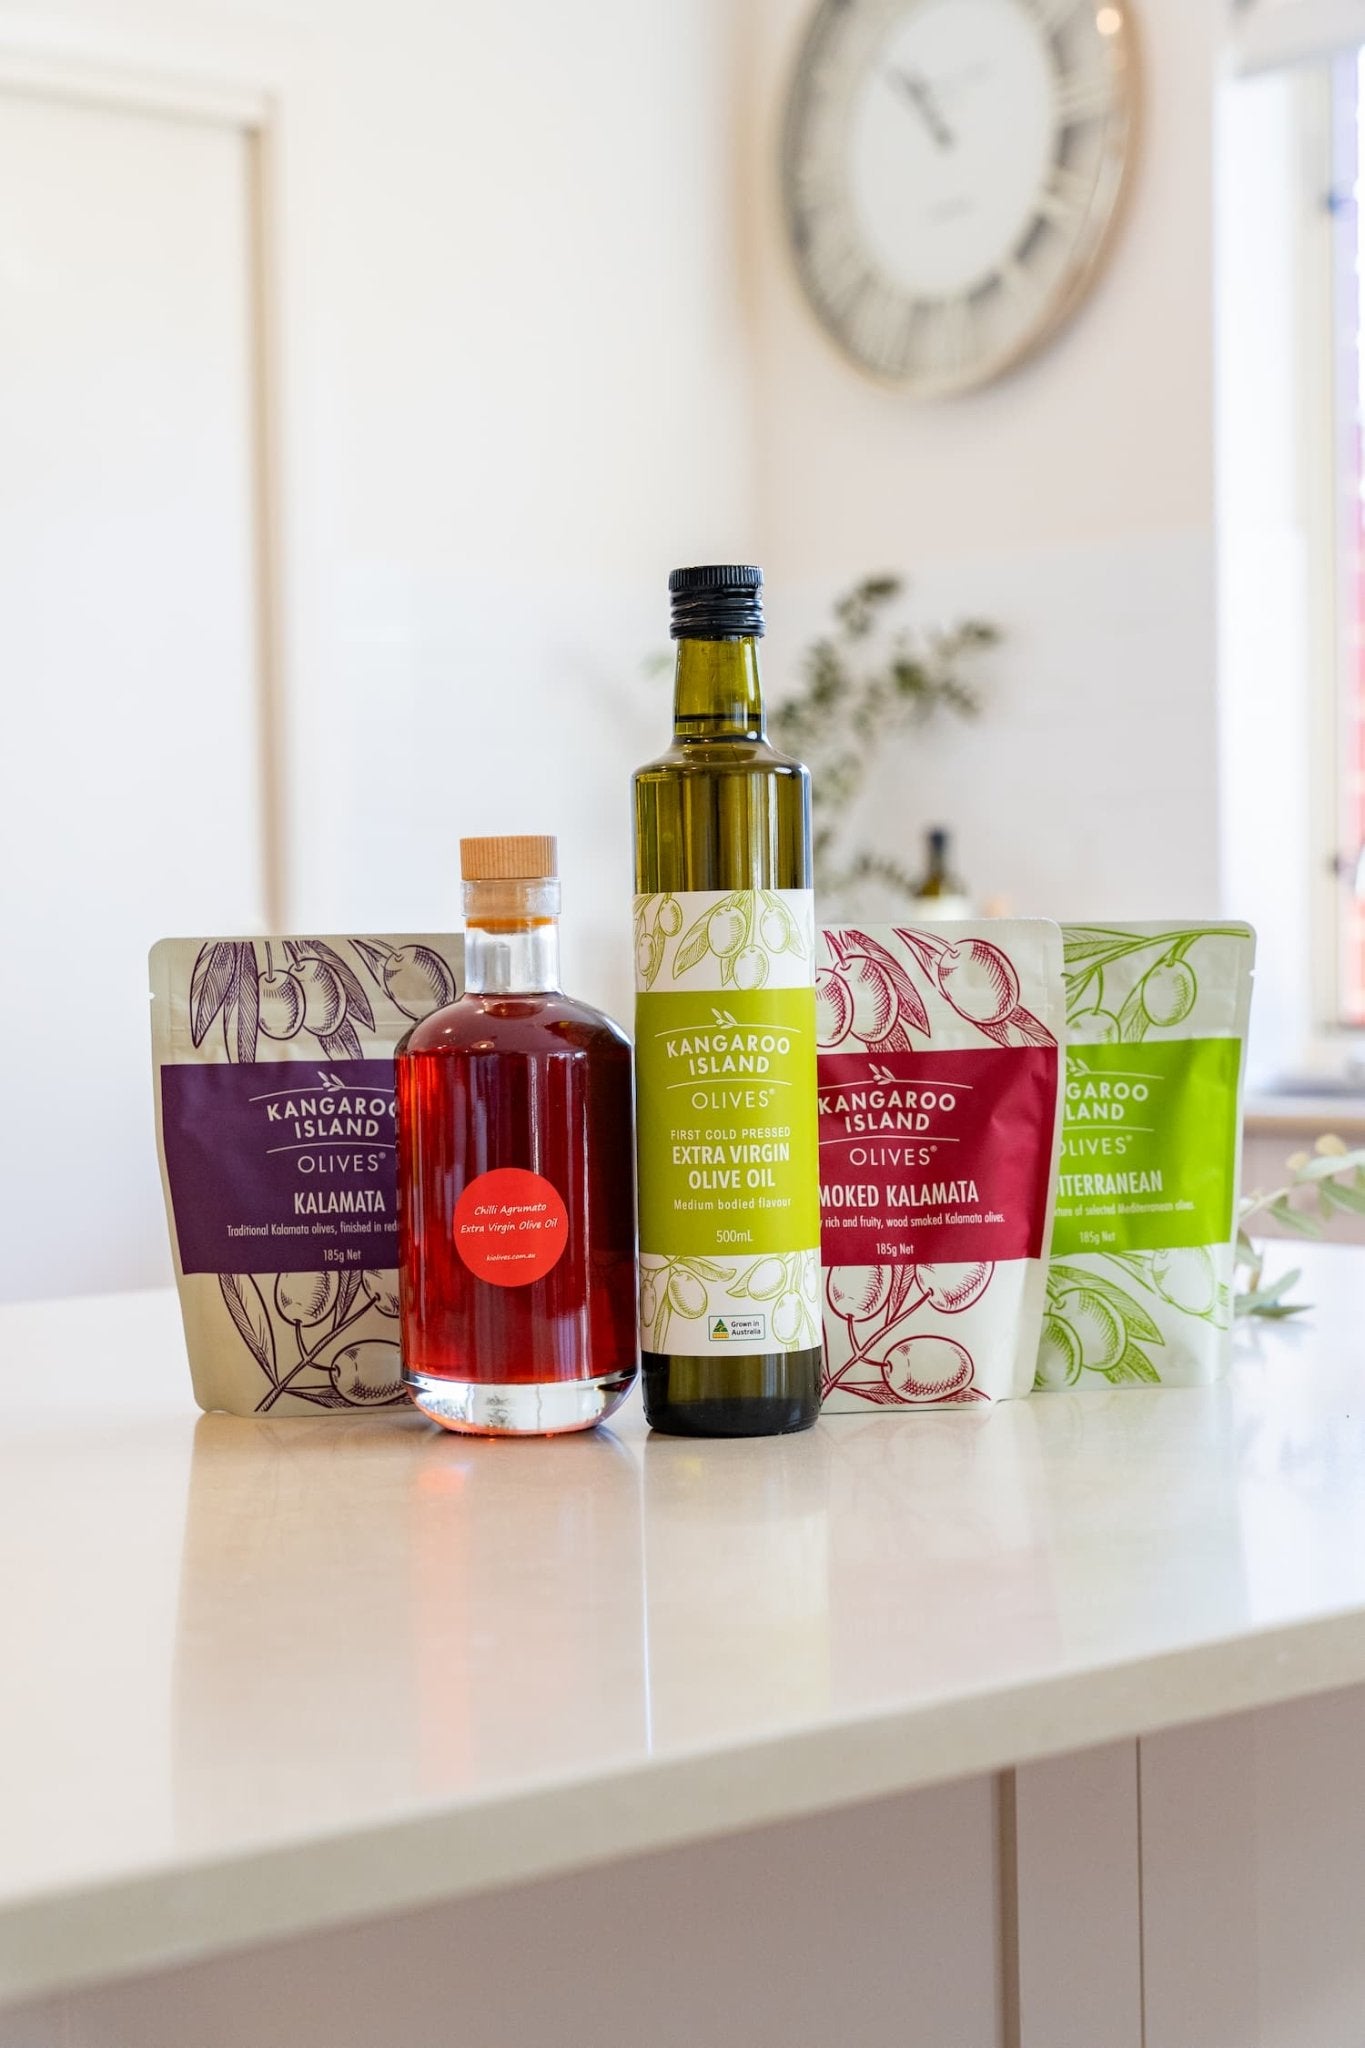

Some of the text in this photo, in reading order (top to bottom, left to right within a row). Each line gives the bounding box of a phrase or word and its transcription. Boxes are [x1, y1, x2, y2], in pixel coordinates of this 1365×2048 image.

[666, 1034, 790, 1058] KANGAROO
[689, 1055, 769, 1076] ISLAND
[1066, 1082, 1148, 1101] GAROO
[818, 1090, 956, 1115] KANGAROO
[1066, 1102, 1125, 1121] LAND
[294, 1118, 379, 1139] ISLAND
[845, 1111, 930, 1133] ISLAND
[670, 1126, 791, 1141] FIRST COLD PRESSED
[672, 1142, 790, 1165] EXTRA VIRGIN
[688, 1168, 776, 1189] OLIVE OIL
[1057, 1169, 1163, 1197] ITERRANEAN
[294, 1190, 386, 1215] KALAMATA
[673, 1196, 792, 1211] Medium bodied flavour
[818, 1180, 980, 1208] MOKED KALAMATA
[474, 1203, 547, 1216] Chilli Agrumato
[227, 1223, 270, 1237] Traditional
[271, 1223, 310, 1236] Kalamata
[312, 1222, 338, 1236] olives,
[340, 1220, 373, 1234] finished
[374, 1221, 382, 1233] in
[461, 1218, 558, 1234] Extra Virgin Olive Oil
[825, 1216, 840, 1228] rich
[842, 1216, 858, 1228] and
[860, 1216, 884, 1230] fruity,
[886, 1215, 909, 1228] wood
[910, 1214, 943, 1227] smoked
[945, 1211, 983, 1225] Kalamata
[984, 1210, 1006, 1224] olives.
[716, 1229, 754, 1243] 500mL
[323, 1249, 362, 1264] 185g Net
[486, 1253, 537, 1262] kiolives.com.au
[876, 1243, 915, 1258] 185g Net
